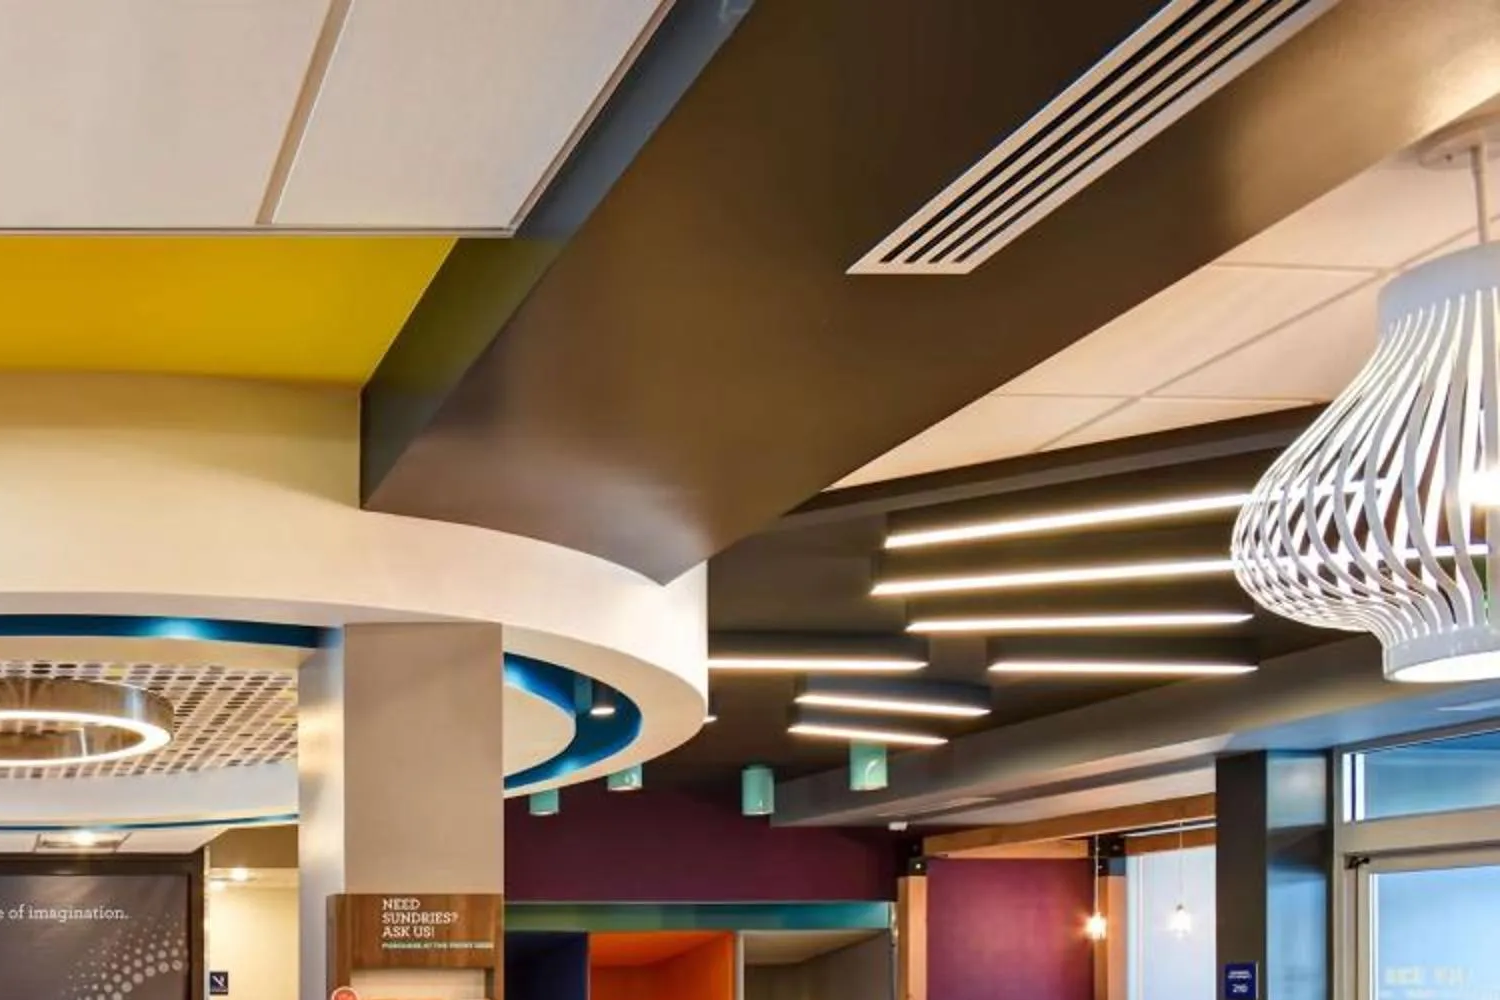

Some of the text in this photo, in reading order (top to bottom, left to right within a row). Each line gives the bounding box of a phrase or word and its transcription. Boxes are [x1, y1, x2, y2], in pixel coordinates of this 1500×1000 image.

[381, 898, 421, 911] NEED
[8, 904, 26, 920] of
[28, 904, 130, 923] imagination.
[381, 912, 459, 925] SUNDRIES?
[381, 926, 435, 939] ASK US!
